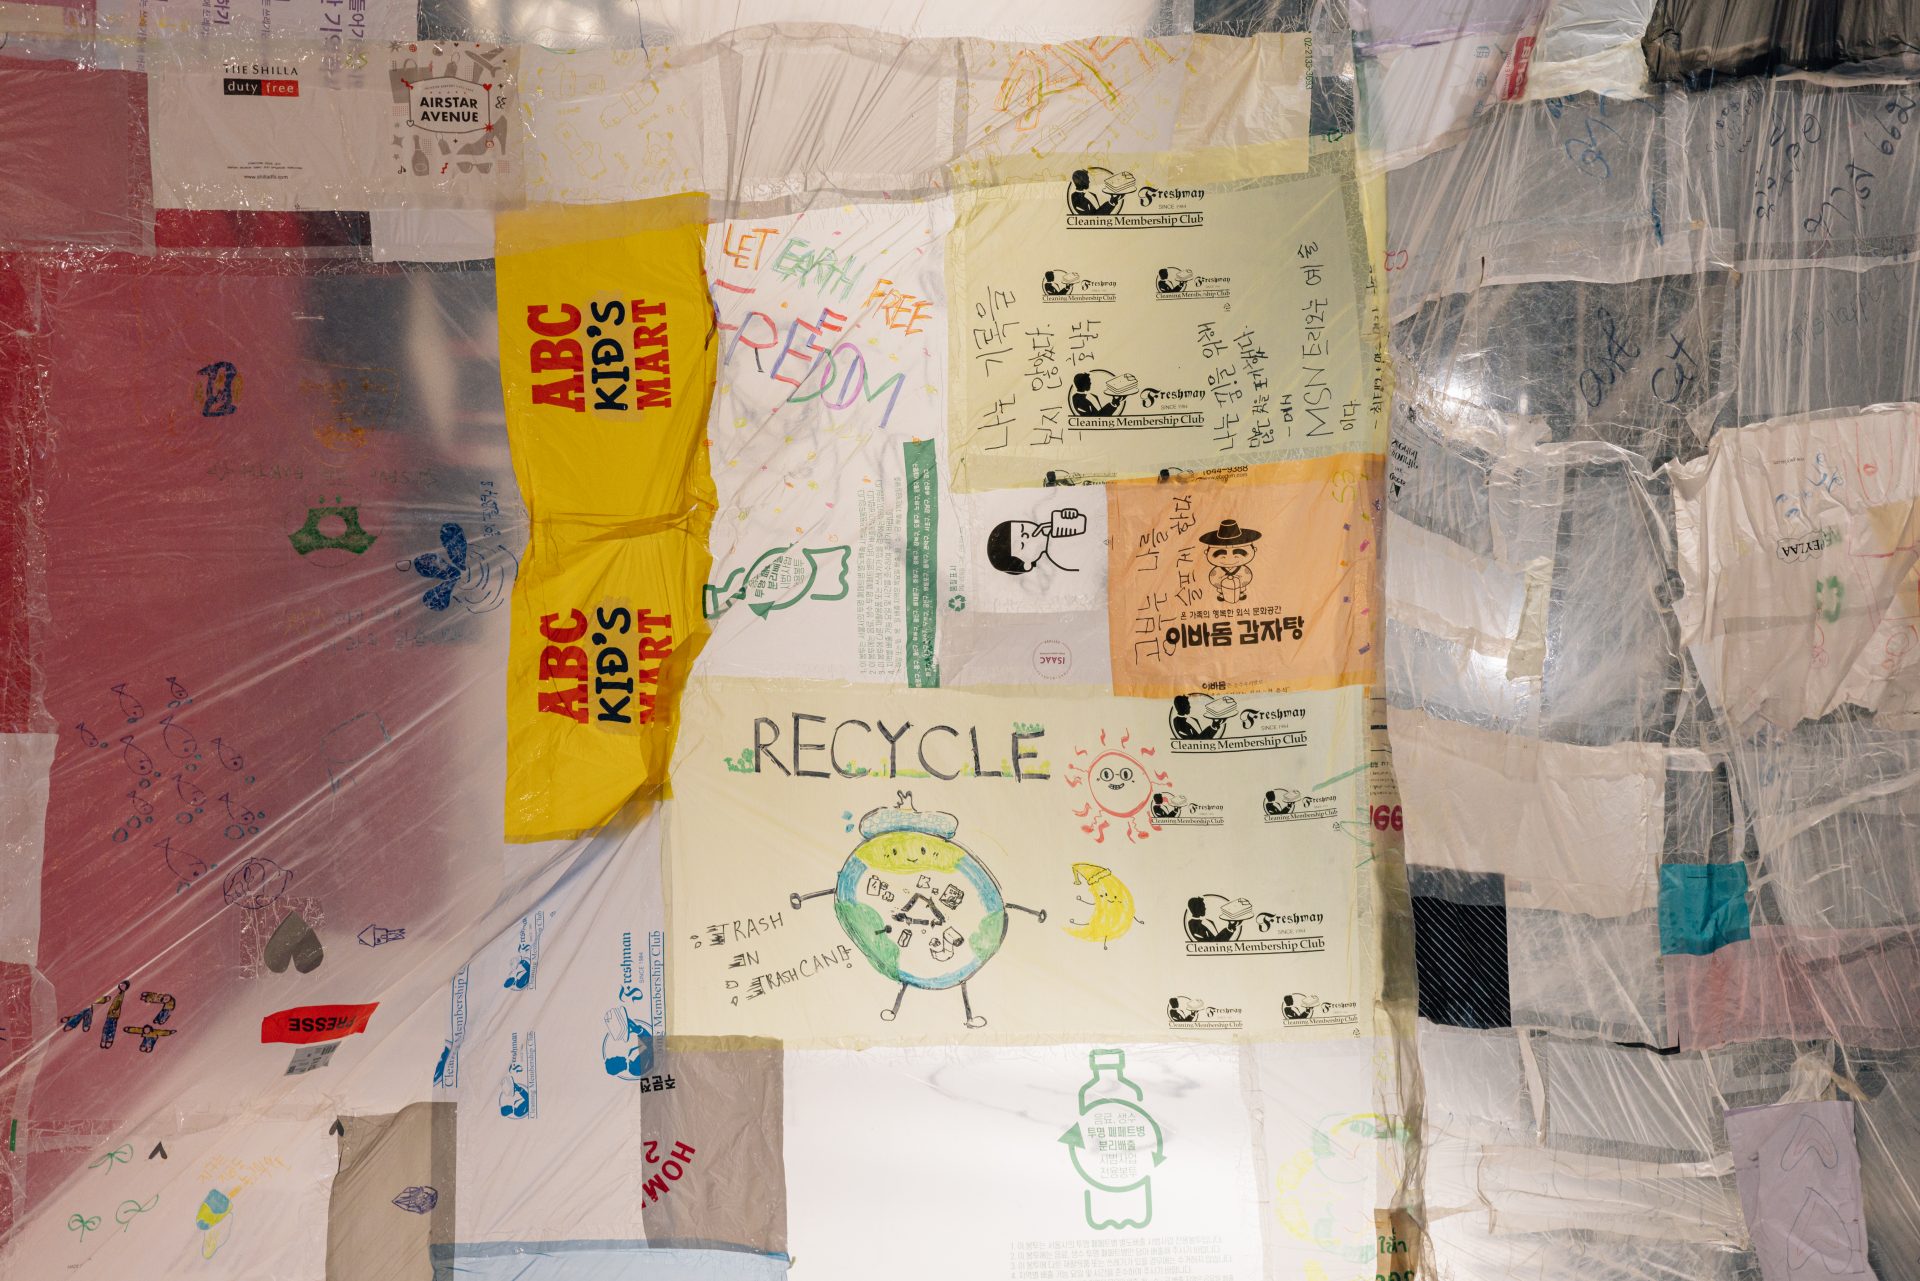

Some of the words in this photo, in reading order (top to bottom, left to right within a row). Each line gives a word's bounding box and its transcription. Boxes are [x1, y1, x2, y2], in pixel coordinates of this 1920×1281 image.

[228, 81, 258, 94] duty
[266, 82, 294, 94] free
[252, 65, 298, 75] SHILLA
[420, 97, 478, 109] AIRSTAR
[421, 111, 478, 122] AVENUE
[1066, 216, 1113, 226] Cleaning
[1114, 216, 1178, 227] Membership
[1179, 214, 1204, 224] Club
[723, 224, 779, 270] LET
[771, 238, 866, 301] EARTH
[861, 278, 935, 336] FREE
[973, 286, 1020, 377] 기록을
[1066, 319, 1102, 367] 호날두
[1196, 321, 1229, 359] 위해
[528, 302, 585, 412] ABC
[590, 300, 629, 411] KID'S
[630, 299, 672, 410] MART
[1068, 417, 1115, 428] Cleaning
[1116, 416, 1179, 427] Membership
[1180, 414, 1205, 424] Club
[1301, 367, 1334, 437] MSN
[976, 394, 1017, 451] 나는
[1030, 406, 1064, 446] 보지
[1212, 413, 1240, 451] 나는
[1135, 527, 1169, 572] 나를
[1134, 592, 1178, 666] 공부는
[1166, 621, 1232, 648] 이바돔
[1237, 616, 1304, 645] 감자탕
[538, 608, 588, 724] ABC
[1039, 656, 1065, 665] ISAAC
[754, 712, 1051, 784] RECYCLE
[1170, 741, 1217, 751] Cleaning
[1218, 737, 1282, 749] Membership
[1283, 733, 1307, 745] Club
[651, 930, 661, 957] Club
[1186, 943, 1233, 953] Cleaning
[1234, 941, 1298, 952] Membership
[1299, 939, 1325, 949] Club
[618, 931, 644, 1003] Freshman
[454, 976, 465, 1044] Membership
[652, 958, 665, 1028] Membership
[288, 1015, 356, 1032] PRESSE
[643, 1140, 660, 1164] 2
[1087, 1127, 1106, 1139] 투명
[641, 1140, 696, 1209] HOM
